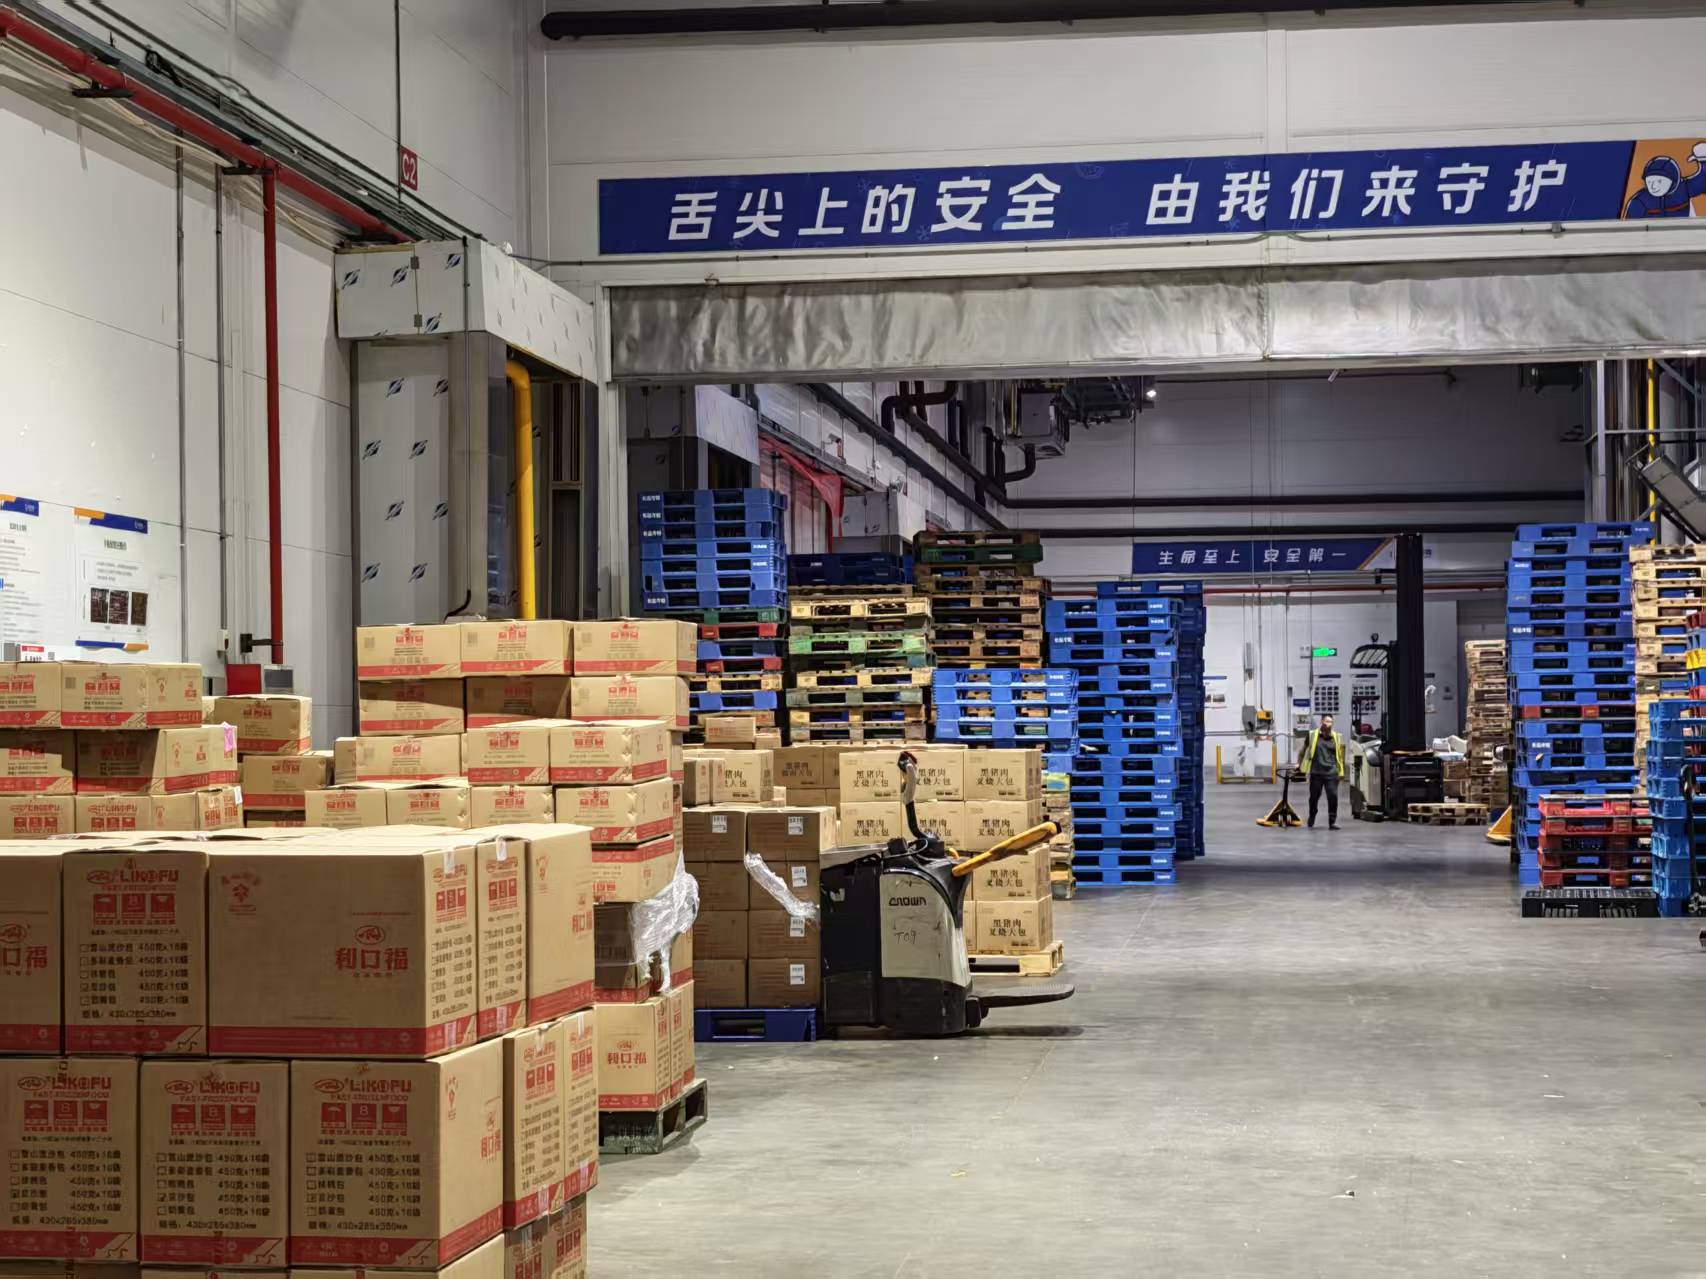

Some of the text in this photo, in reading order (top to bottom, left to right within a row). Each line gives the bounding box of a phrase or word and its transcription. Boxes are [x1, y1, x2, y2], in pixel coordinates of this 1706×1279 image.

[402, 153, 416, 185] C2
[668, 159, 1567, 240] 舌尖上的安全 由我们来守护
[1158, 547, 1347, 566] 生命至上 安全第一
[856, 769, 884, 778] 黑猪肉
[918, 767, 946, 776] 黑猪肉
[980, 768, 1009, 777] 黑猪肉
[853, 778, 889, 787] 叉烧大包
[976, 777, 1014, 786] 叉烧大包
[856, 819, 885, 828] 黑猪肉
[919, 818, 947, 827] 黑猪肉
[982, 818, 1010, 827] 黑猪肉
[853, 828, 889, 837] 叉烧大包
[990, 869, 1019, 878] 黑猪肉
[986, 878, 1023, 888] 叉烧大包
[889, 896, 927, 906] CROWN
[993, 918, 1021, 928] 黑猪肉
[989, 928, 1026, 937] 叉烧大包
[0, 946, 48, 968] 口福
[335, 947, 409, 971] 利口福
